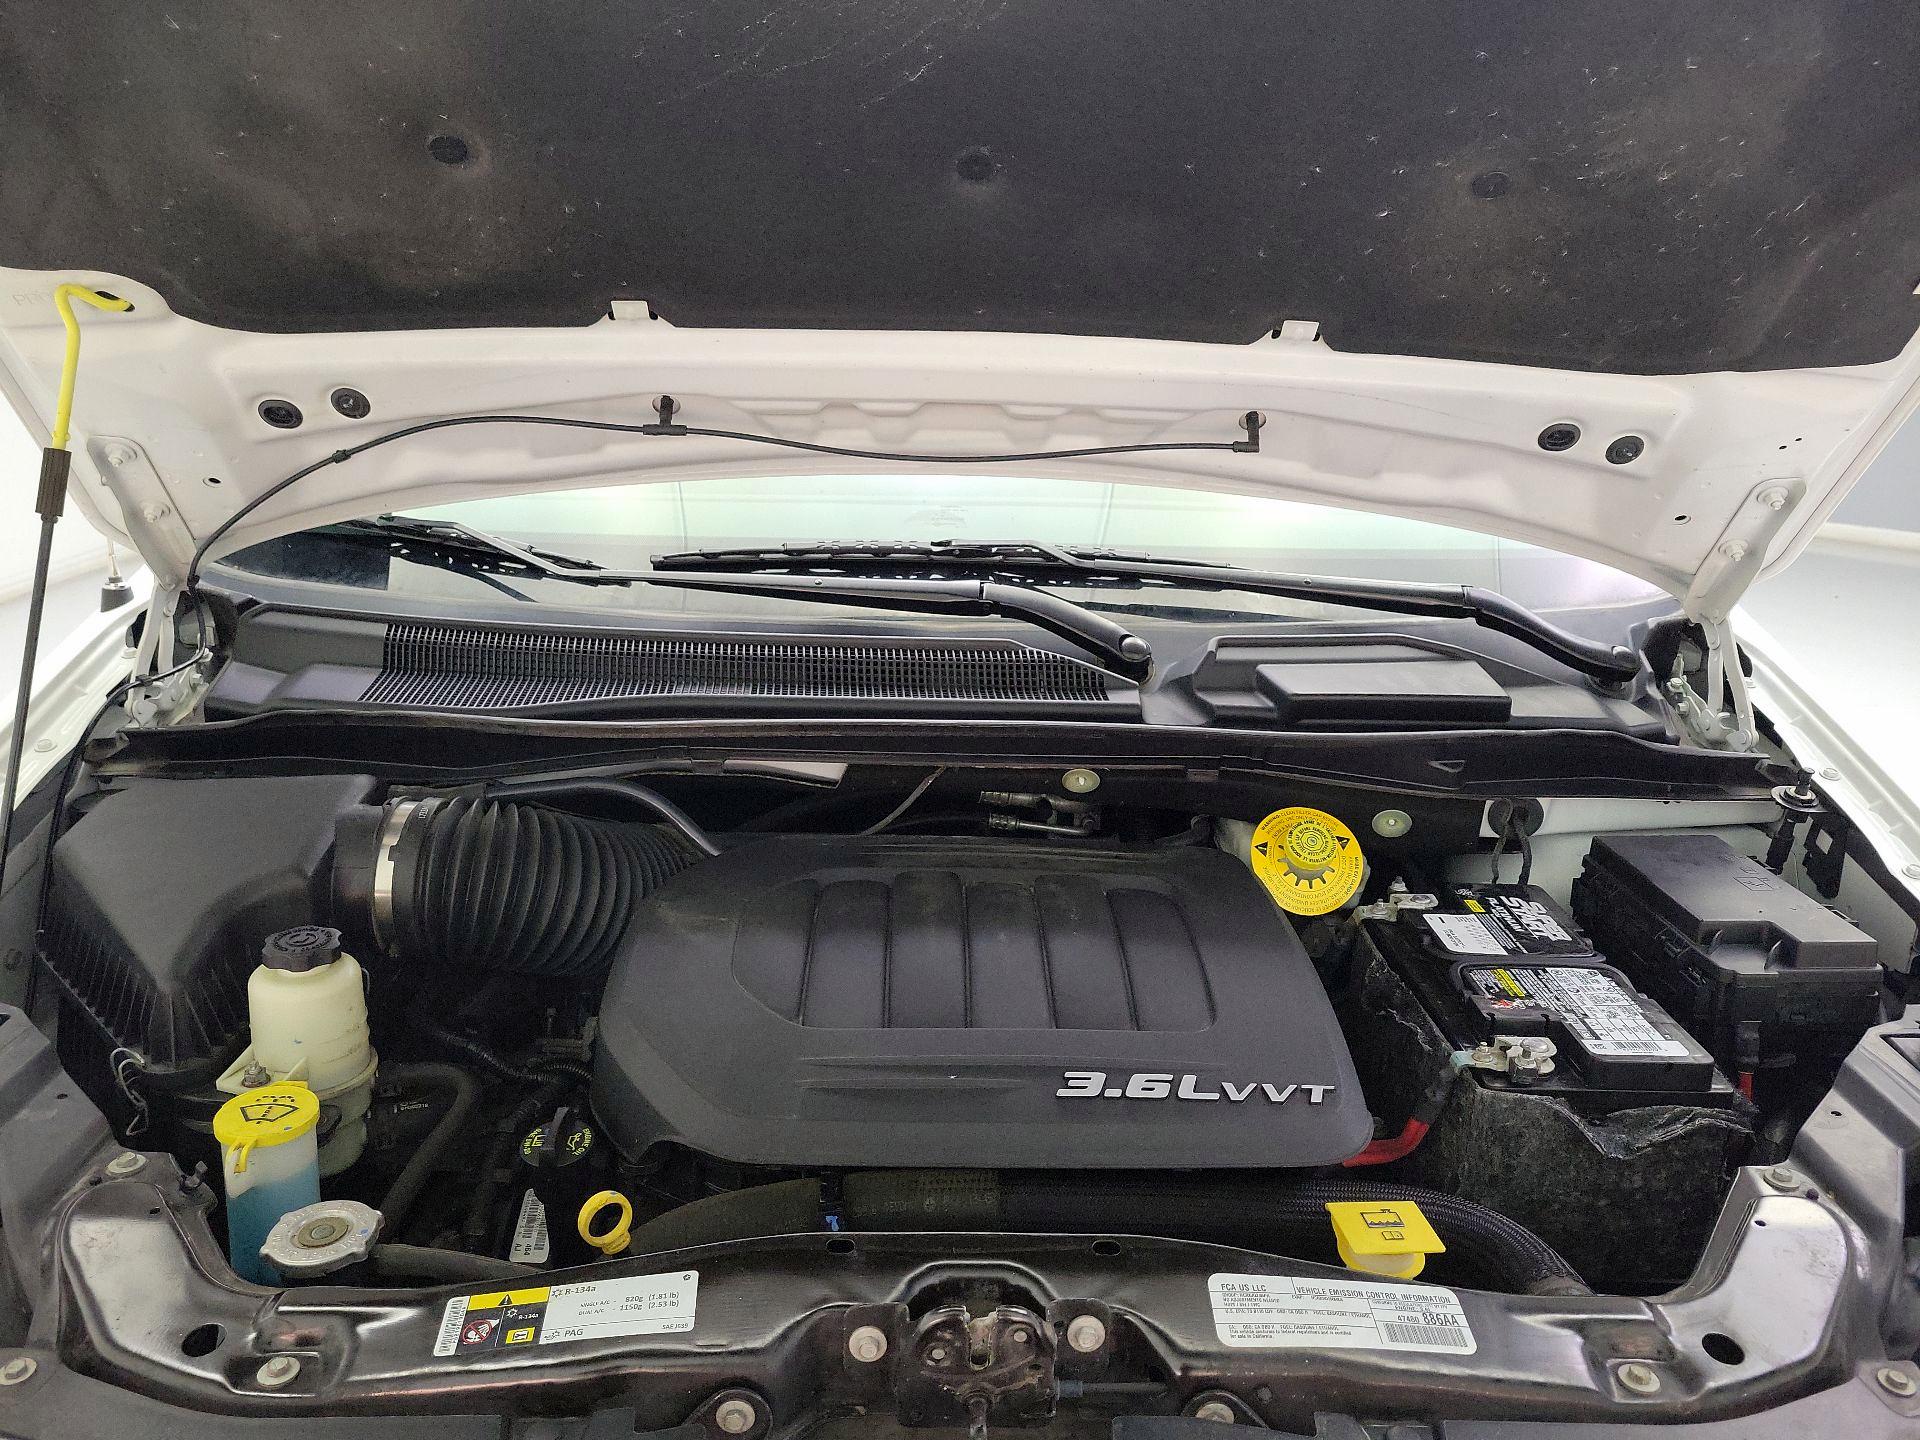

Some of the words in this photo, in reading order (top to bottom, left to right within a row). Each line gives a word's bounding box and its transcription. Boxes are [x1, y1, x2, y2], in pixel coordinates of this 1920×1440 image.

[1500, 895, 1550, 938] START
[1055, 1071, 1220, 1100] 3.6L
[1221, 1081, 1336, 1105] VVT
[582, 1127, 592, 1147] ENGINE
[571, 1147, 586, 1156] OIL
[564, 1285, 597, 1296] R-134a
[1221, 1283, 1236, 1291] FCA
[1239, 1284, 1250, 1292] US
[1252, 1284, 1267, 1292] LLC
[669, 1292, 680, 1301] lb)
[1296, 1286, 1327, 1296] VEHICLE
[1328, 1288, 1364, 1298] EMISSION
[1365, 1290, 1398, 1300] CONTROL
[1400, 1292, 1451, 1304] INFORMATION
[669, 1300, 680, 1309] lb)
[1422, 1312, 1460, 1326] 886AA
[564, 1328, 583, 1337] PAG
